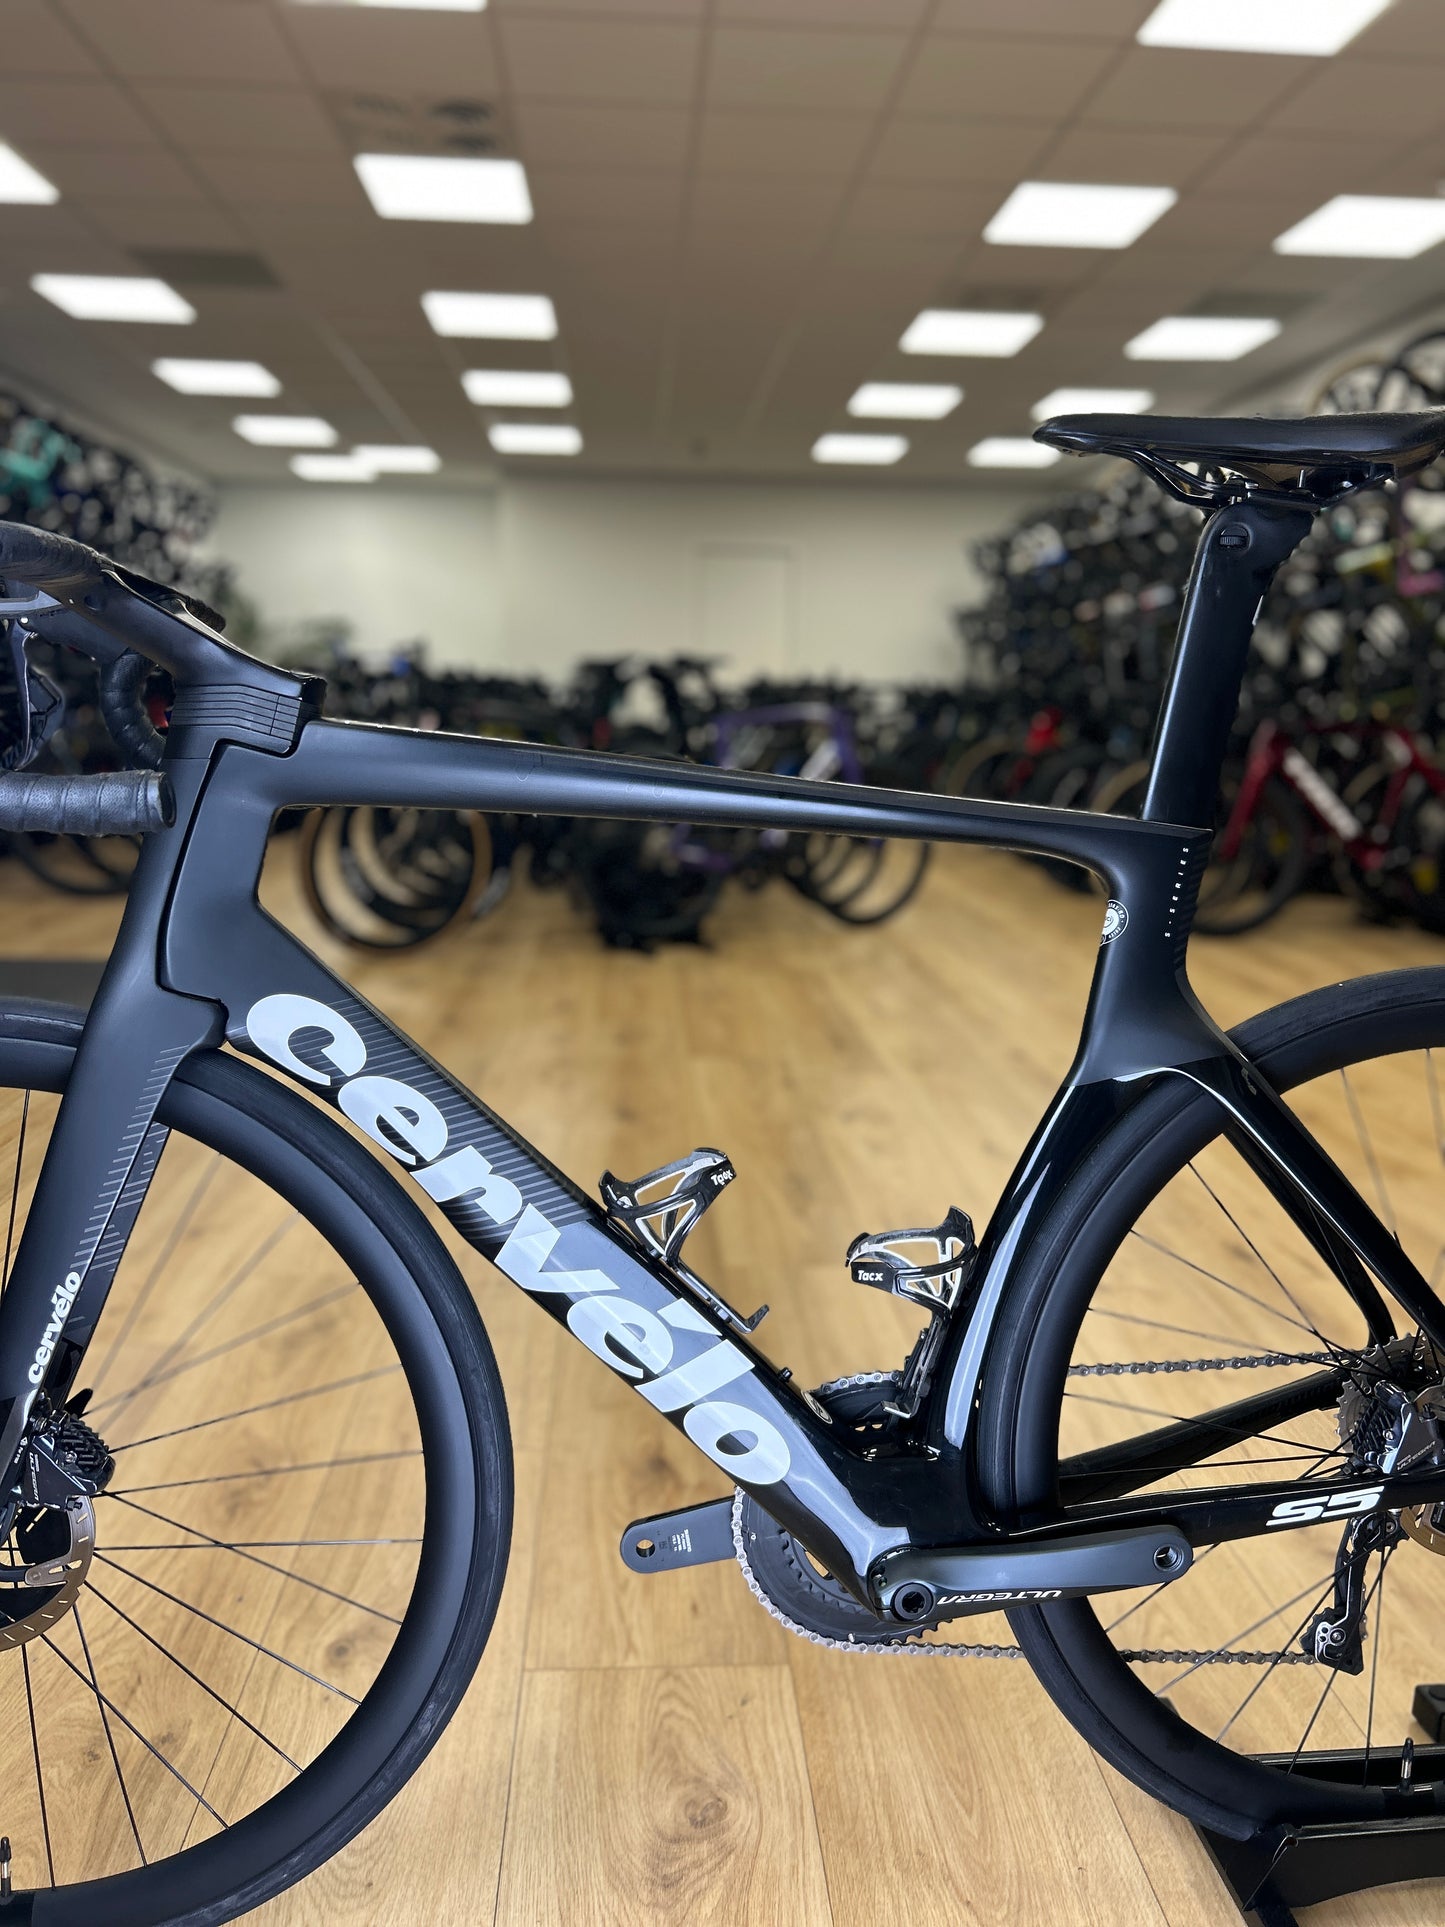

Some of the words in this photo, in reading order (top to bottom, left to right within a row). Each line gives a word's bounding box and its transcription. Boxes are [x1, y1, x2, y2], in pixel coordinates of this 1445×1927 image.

[246, 993, 791, 1485] cervélo
[857, 1269, 884, 1282] Tacx
[28, 1271, 81, 1384] cervélo
[1265, 1485, 1385, 1527] S5
[936, 1589, 1063, 1605] ULTEGRA
